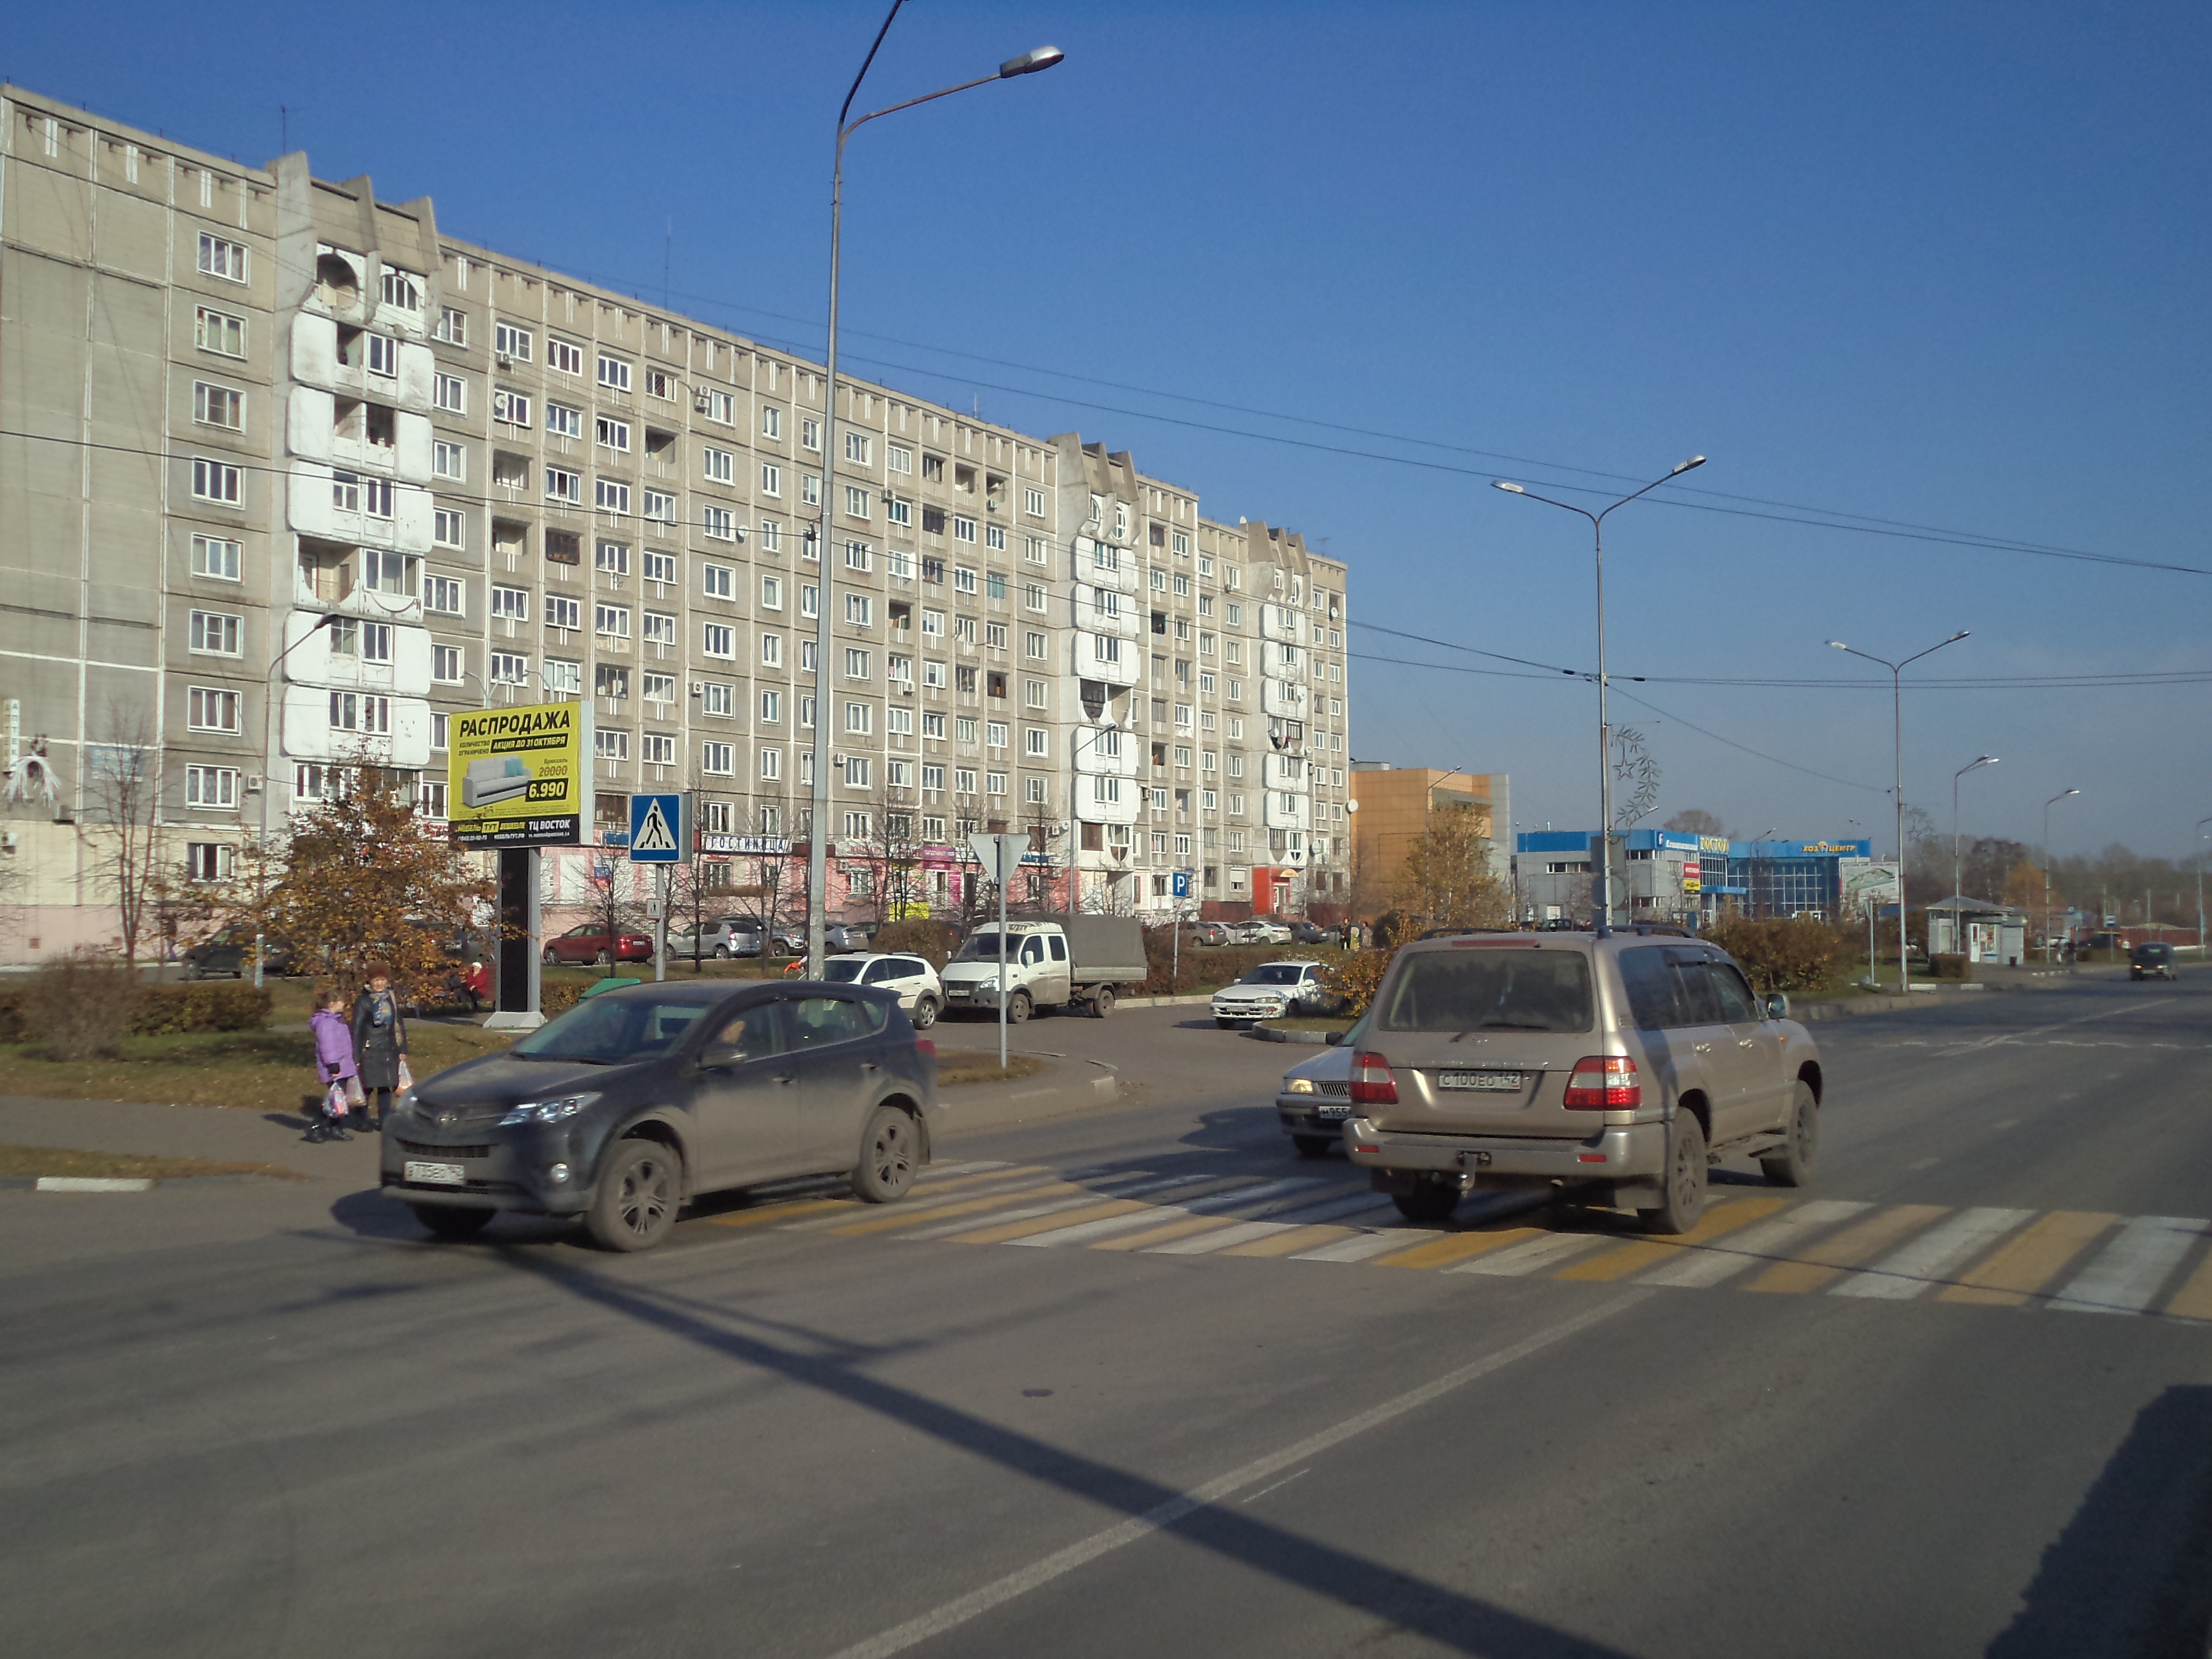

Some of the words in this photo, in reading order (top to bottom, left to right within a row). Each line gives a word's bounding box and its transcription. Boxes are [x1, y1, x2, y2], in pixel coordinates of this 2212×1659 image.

[459, 710, 570, 737] РАСПРОДАЖА
[459, 740, 490, 748] КОЛИЧЕСТВО
[493, 740, 515, 749] АКЦИЯ
[526, 739, 533, 747] 31
[534, 735, 565, 746] ОКТЯБРЯ
[538, 765, 567, 777] 20000
[529, 781, 565, 798] 6.990
[529, 820, 539, 831] ТЦ
[540, 819, 571, 830] ВОСТОК
[711, 837, 783, 851] ГОСТИНИЦА
[1177, 876, 1185, 893] P
[1322, 1107, 1351, 1117] М955
